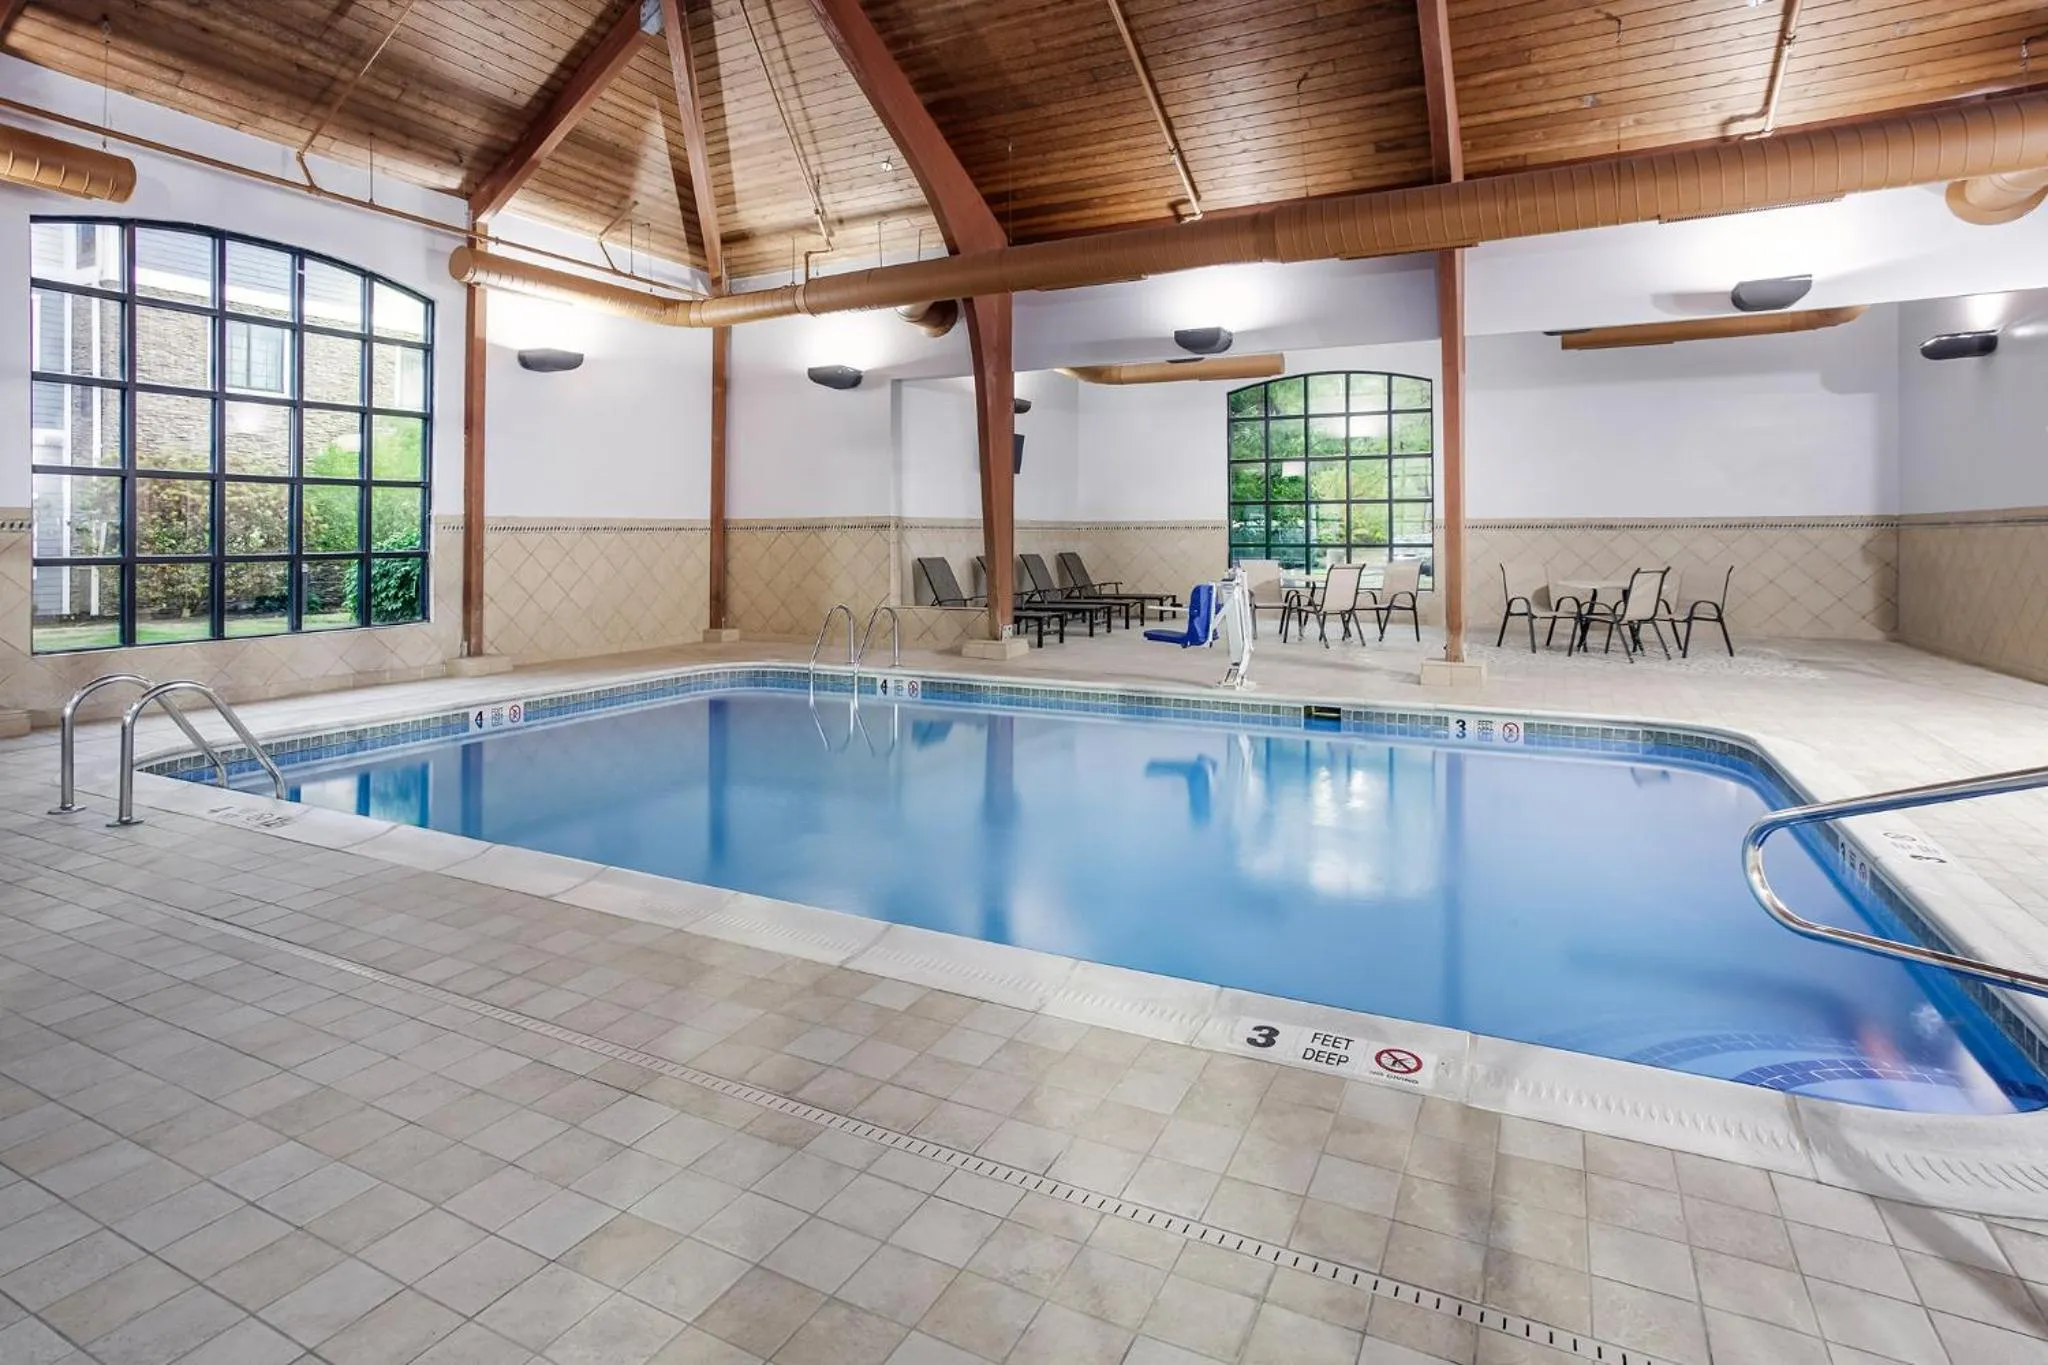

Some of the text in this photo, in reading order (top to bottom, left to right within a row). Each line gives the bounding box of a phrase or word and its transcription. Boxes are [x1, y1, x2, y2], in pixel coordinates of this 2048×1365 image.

[1456, 719, 1466, 739] 3
[1246, 1025, 1280, 1048] 3
[1311, 1032, 1354, 1051] FEET
[1302, 1047, 1349, 1067] DEEP
